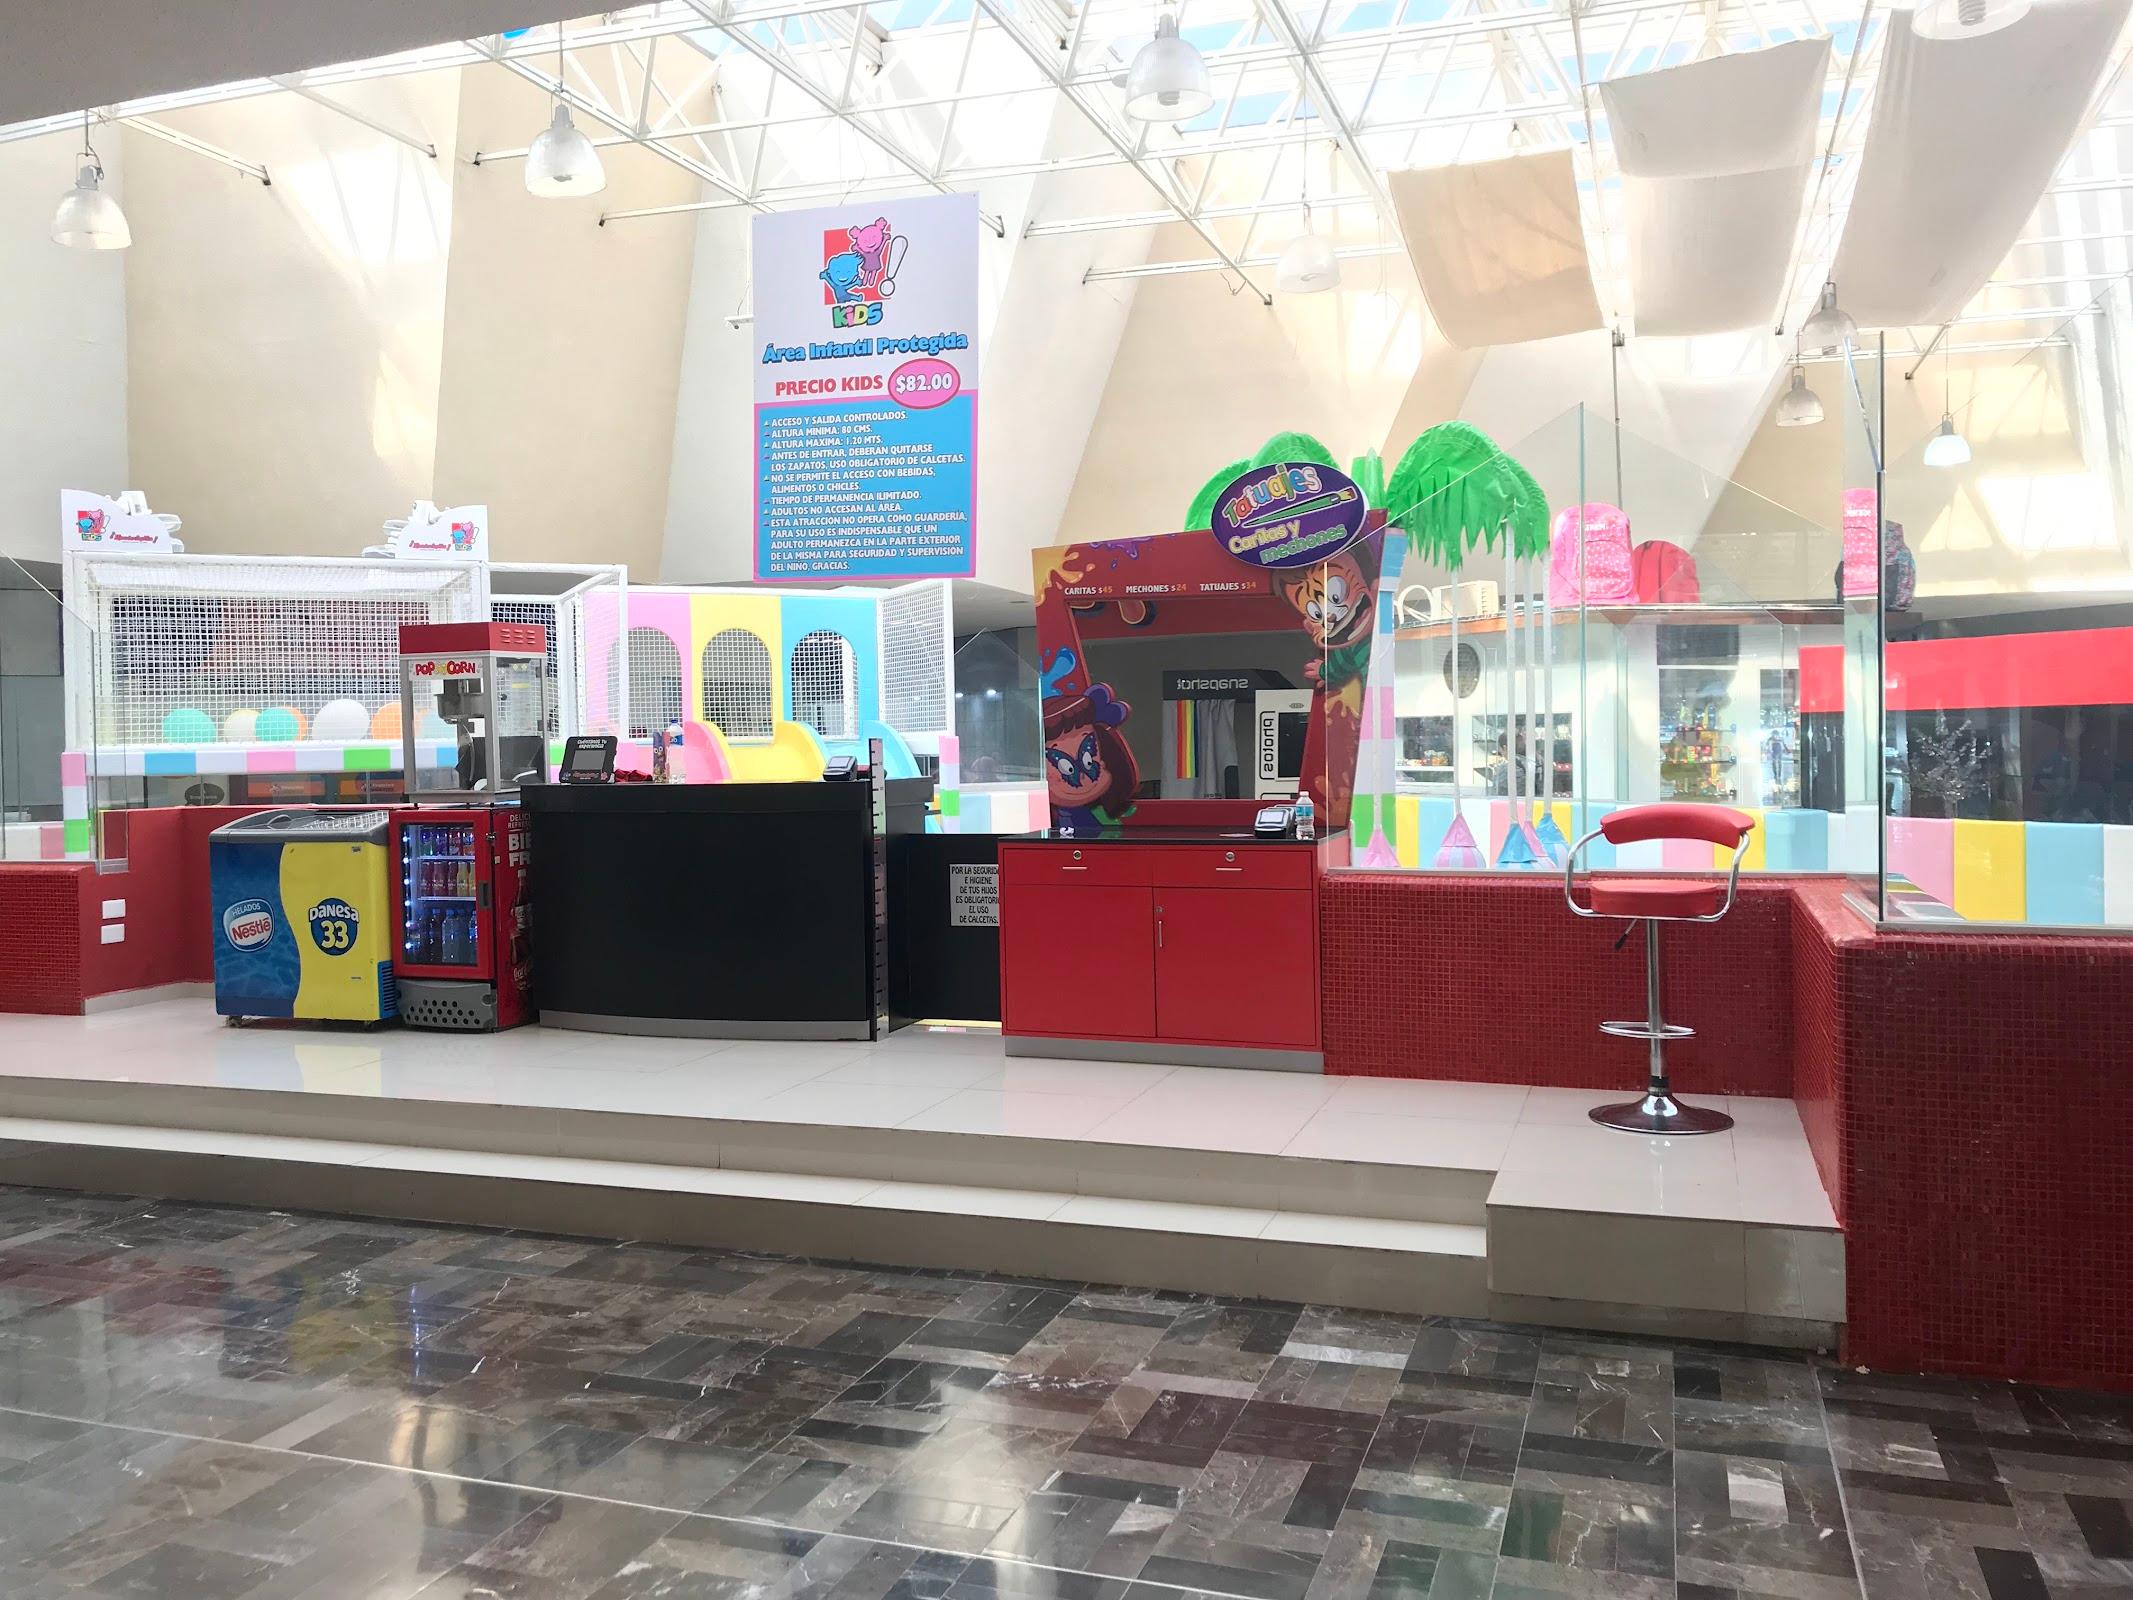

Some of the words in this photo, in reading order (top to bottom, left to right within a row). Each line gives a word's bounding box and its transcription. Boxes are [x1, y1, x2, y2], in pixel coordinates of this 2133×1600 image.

[762, 343, 806, 364] Área
[809, 337, 874, 360] Infantil
[876, 332, 968, 356] Protegida
[775, 378, 837, 397] PRECIO
[841, 375, 884, 392] KIDS
[895, 371, 953, 395] $82.00
[771, 417, 802, 427] ACCESO
[804, 417, 810, 425] Y
[812, 415, 842, 425] SALIDA
[843, 411, 908, 422] CONTROLADOS.
[771, 427, 804, 438] ALTURA
[841, 425, 852, 434] 80
[853, 424, 873, 433] CMS.
[771, 439, 804, 449] ALTURA
[846, 436, 862, 445] 1.20
[864, 435, 883, 444] MTS.
[771, 450, 797, 461] ANTES
[799, 450, 810, 459] DE
[890, 444, 933, 455] QUITARSE
[771, 462, 786, 471] LOS
[829, 459, 846, 469] USO
[848, 457, 905, 468] OBLIGATORIO
[907, 456, 918, 465] DE
[920, 454, 966, 464] CALCETAS.
[771, 474, 784, 482] NO
[785, 474, 795, 482] SE
[796, 472, 830, 481] PERMITE
[832, 472, 840, 480] EL
[842, 470, 874, 479] ACCESO
[877, 469, 895, 478] CON
[897, 467, 936, 477] BEBIDAS,
[771, 484, 817, 494] ALIMENTOS
[818, 484, 825, 492] O
[826, 482, 861, 491] CHICLES.
[1222, 463, 1322, 527] Tatuajes
[771, 496, 801, 505] TIEMPO
[802, 495, 812, 503] DE
[815, 493, 874, 503] PERMANENCIA
[876, 491, 921, 500] ILIMITADO.
[771, 507, 808, 516] ADULTOS
[810, 506, 822, 514] NO
[825, 505, 863, 513] ACCESAN
[865, 504, 876, 512] AL
[771, 518, 790, 527] ESTA
[842, 516, 855, 525] NO
[857, 515, 885, 524] OPERA
[887, 513, 912, 522] COMO
[771, 530, 793, 538] PARA
[795, 529, 806, 537] SU
[827, 528, 836, 536] ES
[838, 526, 902, 536] INDISPENSABLE
[904, 525, 922, 534] QUE
[924, 524, 938, 532] UN
[1286, 519, 1301, 539] y
[771, 541, 803, 549] ADULTO
[805, 539, 861, 548] PERMANEZCA
[863, 538, 875, 546] EN
[889, 537, 917, 545] PARTE
[919, 536, 961, 545] EXTERIOR
[1259, 523, 1348, 564] mechones
[771, 552, 781, 560] DE
[783, 552, 793, 560] LA
[795, 551, 822, 560] MISMA
[849, 549, 897, 558] SEGURIDAD
[771, 564, 784, 572] DEL
[812, 562, 850, 570] GRACIAS.
[1064, 586, 1097, 595] CARITAS
[1125, 584, 1169, 593] MECHONES
[1200, 582, 1240, 591] TATUAJES
[415, 661, 435, 675] POP
[446, 660, 476, 674] CORN
[951, 866, 963, 875] POR
[964, 866, 972, 875] LA
[964, 876, 968, 884] E
[970, 876, 992, 885] HIGIENE
[960, 886, 968, 894] DE
[969, 886, 980, 894] TUS
[981, 886, 998, 894] HIJOS
[231, 902, 261, 917] HELADOS
[969, 905, 976, 914] EL
[977, 905, 989, 914] USO
[960, 915, 967, 923] DE
[231, 917, 272, 941] Nestlé
[320, 920, 349, 949] 33
